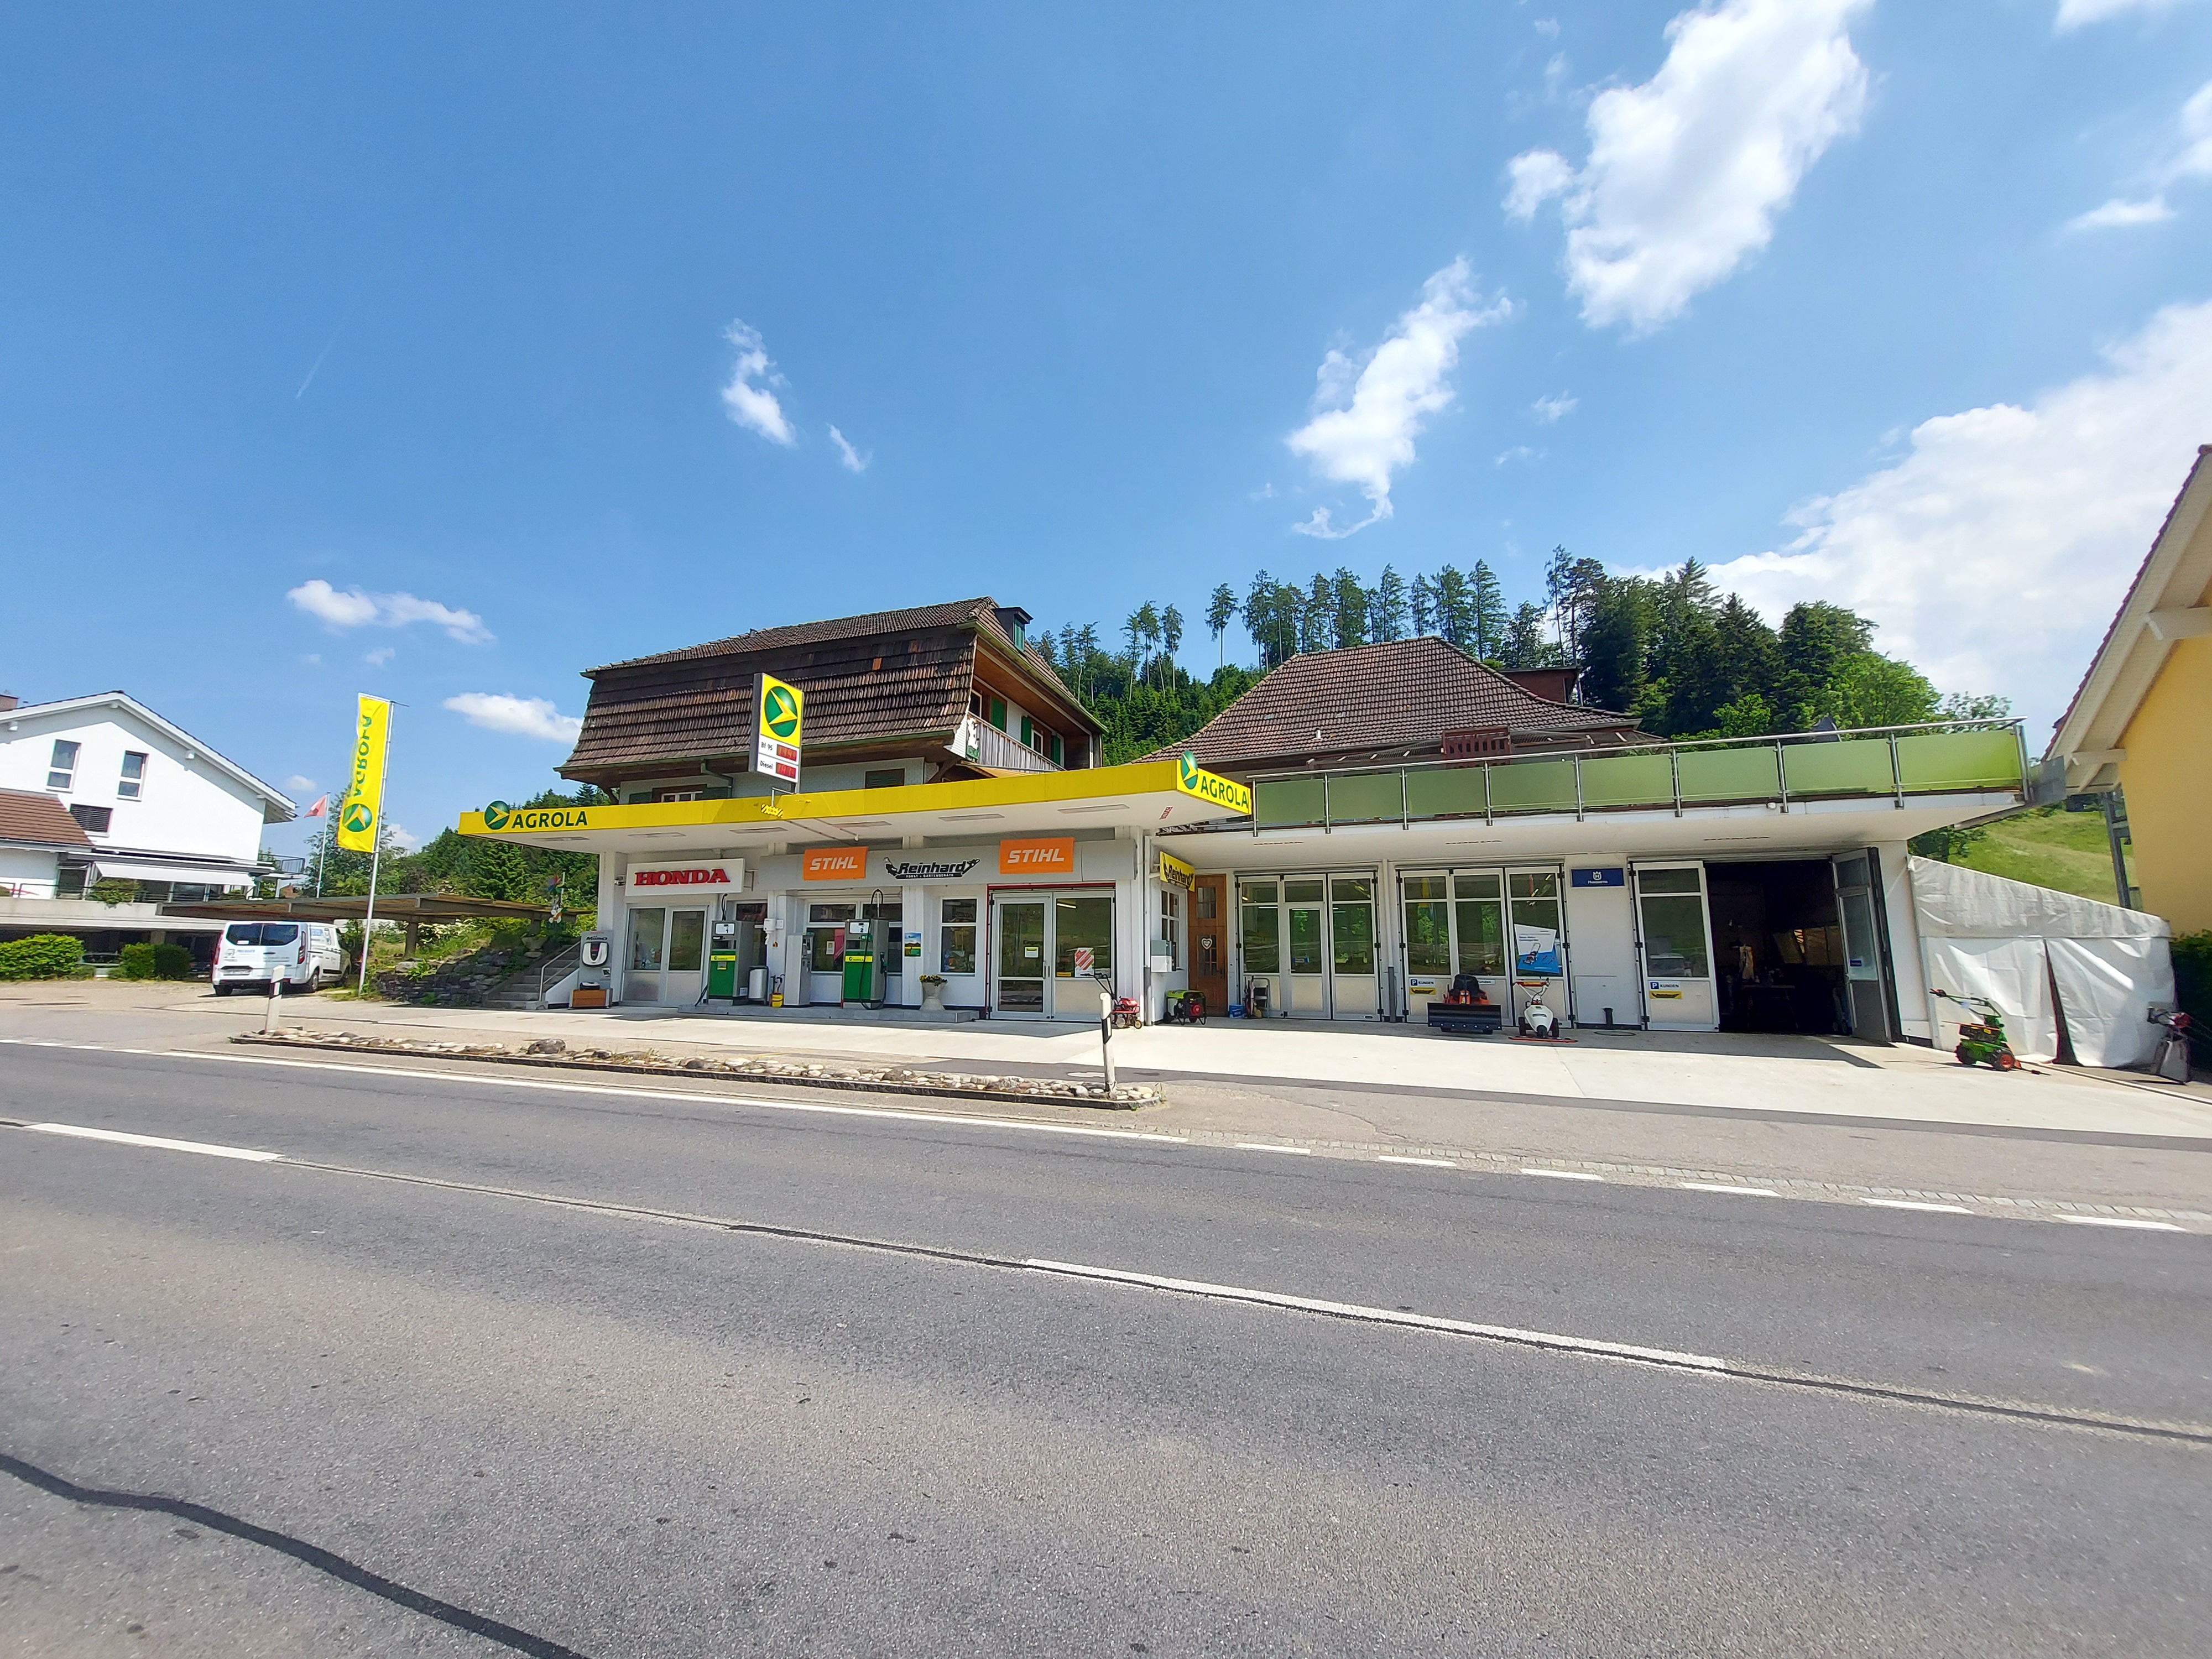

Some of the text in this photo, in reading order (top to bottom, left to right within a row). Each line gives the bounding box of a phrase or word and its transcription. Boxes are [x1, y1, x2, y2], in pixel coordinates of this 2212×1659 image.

[760, 760, 773, 769] Diesel
[1200, 775, 1249, 808] AGROLA
[512, 811, 588, 828] AGROLA
[809, 856, 858, 870] STIHL
[1008, 848, 1065, 863] STIHL
[897, 861, 967, 874] Reinhard
[1168, 863, 1191, 886] Reinhard
[634, 868, 731, 886] HONDA
